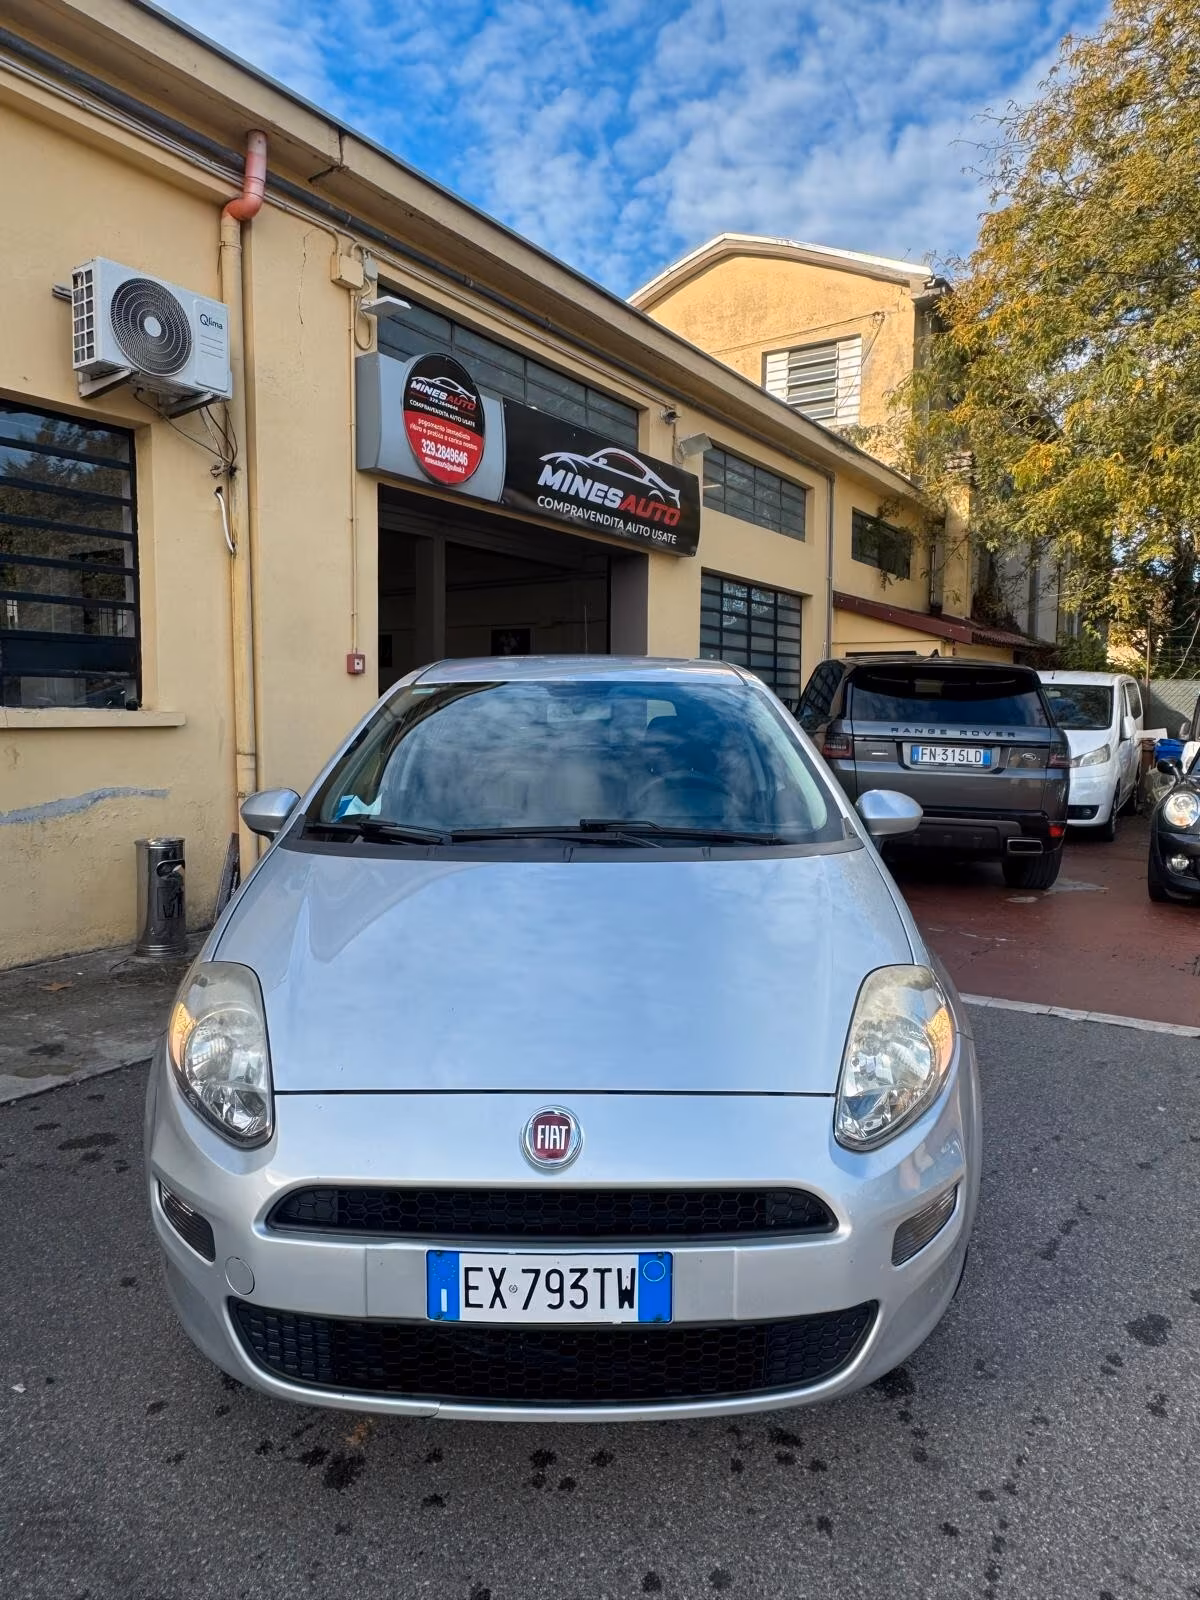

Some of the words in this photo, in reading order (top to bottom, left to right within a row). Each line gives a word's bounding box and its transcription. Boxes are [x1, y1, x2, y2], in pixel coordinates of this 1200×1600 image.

[199, 313, 223, 330] Qlima
[421, 438, 468, 466] 329.2849646
[537, 495, 625, 531] COMPRAVENDITA
[625, 522, 650, 537] AUTO
[651, 530, 678, 545] USATE
[890, 727, 948, 736] RANGE
[959, 730, 1016, 738] ROVER
[537, 1124, 569, 1150] FIAT
